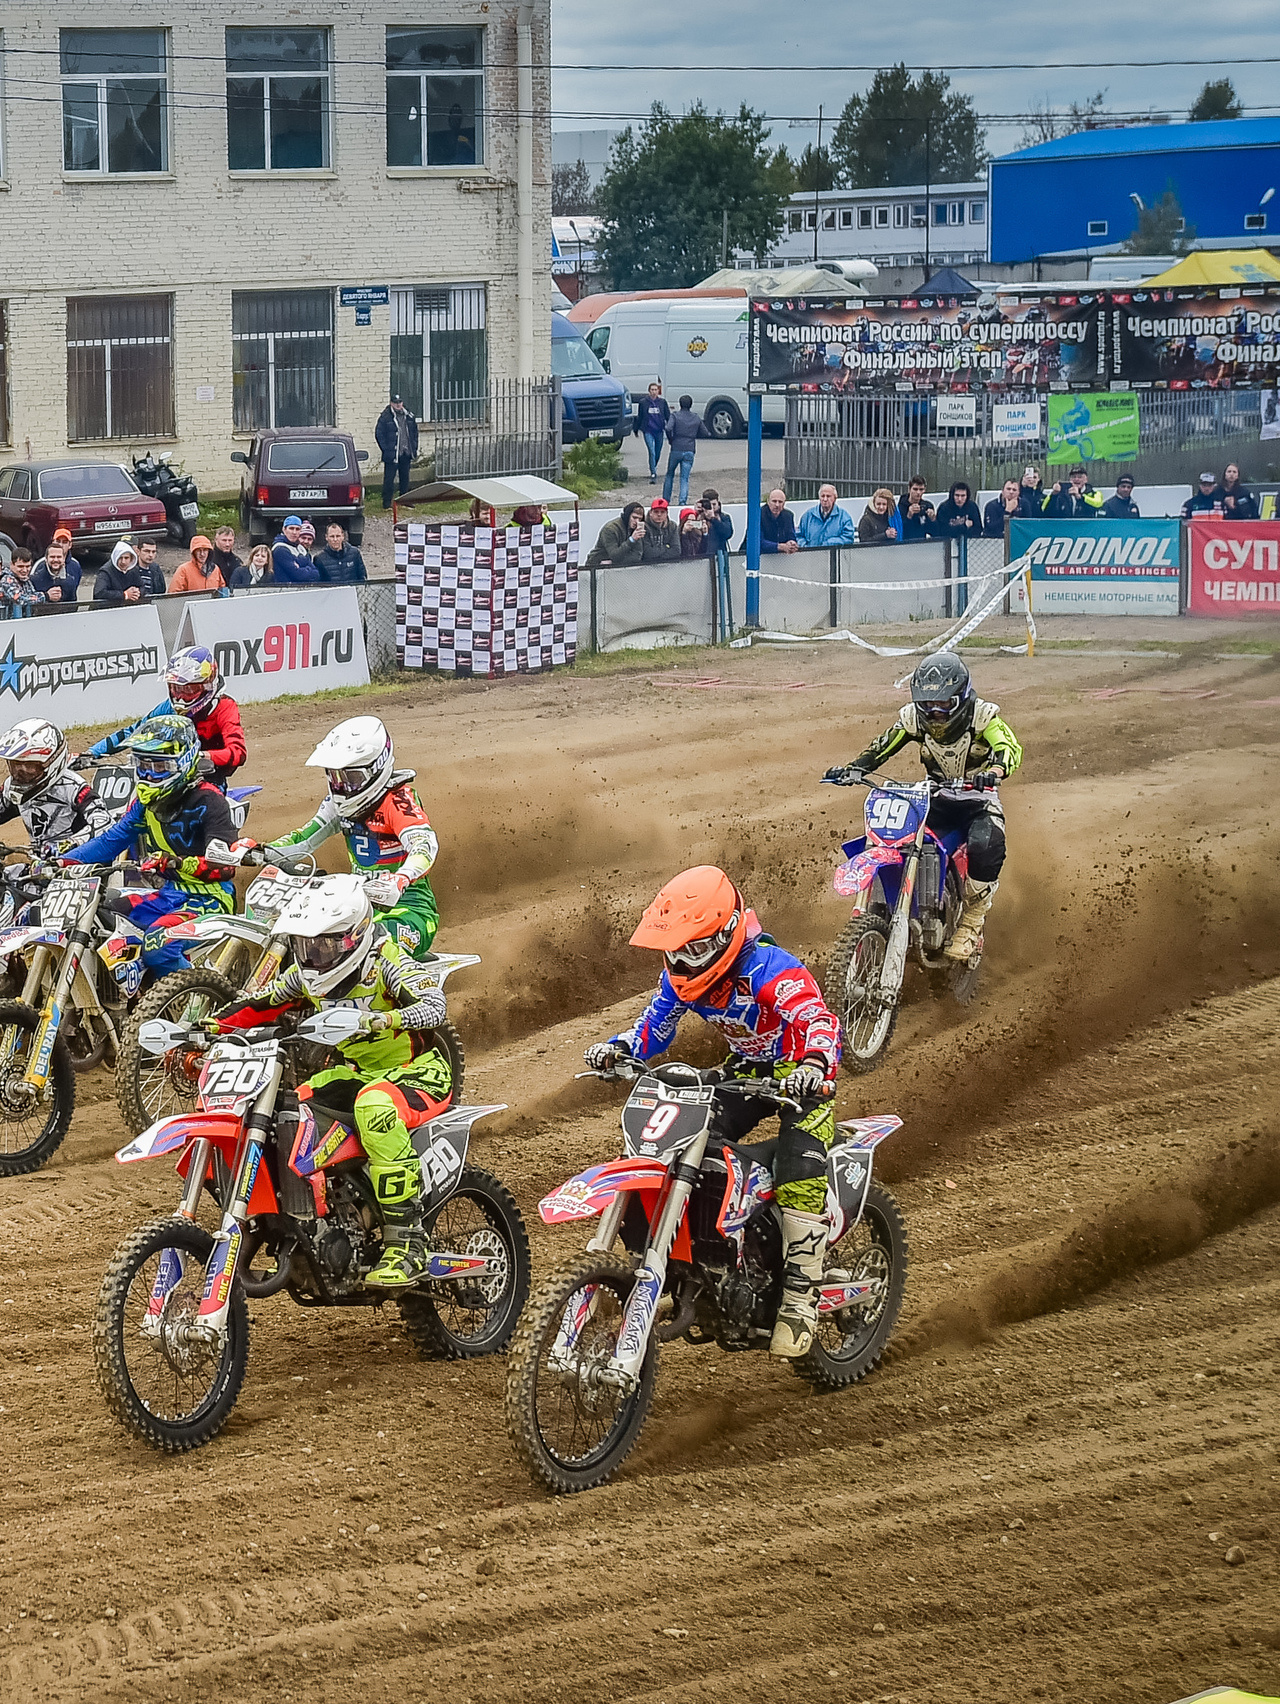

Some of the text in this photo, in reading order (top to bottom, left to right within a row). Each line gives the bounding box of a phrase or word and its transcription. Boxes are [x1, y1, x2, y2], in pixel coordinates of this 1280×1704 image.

[766, 320, 1089, 343] Чемпионат России по суперкроссу
[1127, 315, 1239, 337] Чемпионат
[843, 348, 1003, 370] Финальный этап
[939, 411, 973, 422] ГОНЩИКОВ
[948, 402, 965, 411] ПАРК
[1006, 410, 1026, 419] ПАРК
[995, 423, 1037, 433] ГОНЩИКОВ
[1025, 536, 1173, 566] ADDINOL
[1045, 566, 1065, 576] THE
[1069, 566, 1089, 576] ART
[1093, 566, 1107, 576] OF
[1044, 592, 1097, 602] НЕМЕЦКИЕ
[1098, 592, 1154, 603] МОТОРНЫЕ
[1204, 580, 1280, 601] ЧЕМП
[213, 621, 354, 677] mx911.ru
[97, 775, 134, 800] 110
[870, 798, 911, 830] 99
[42, 889, 91, 920] 505
[202, 1060, 265, 1095] 730
[641, 1103, 680, 1141] 9
[225, 1232, 241, 1278] BRATSK
